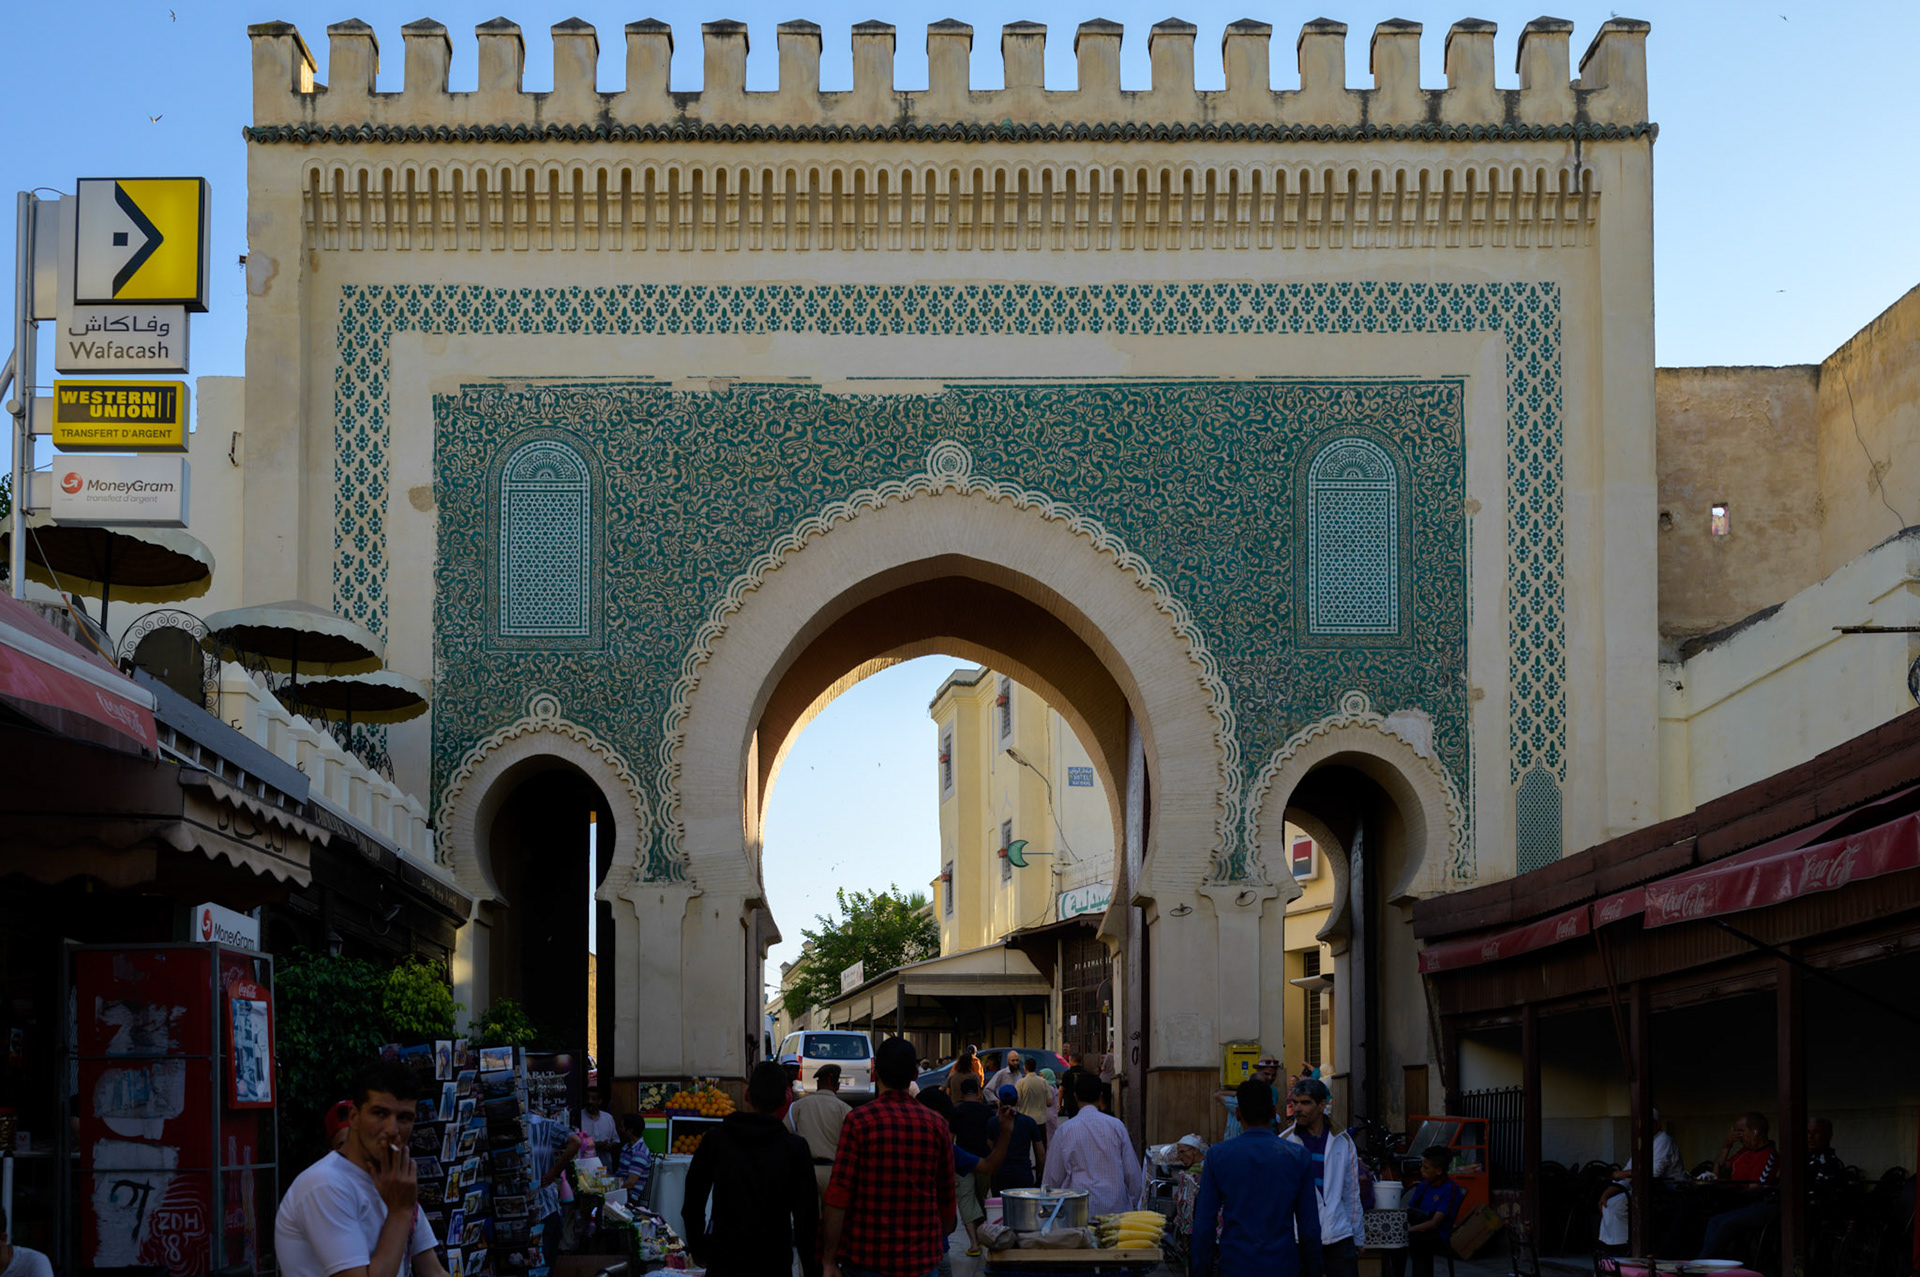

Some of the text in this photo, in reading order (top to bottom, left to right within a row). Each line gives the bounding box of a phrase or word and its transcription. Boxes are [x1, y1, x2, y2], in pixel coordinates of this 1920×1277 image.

[69, 315, 170, 337] وفاكاش
[69, 341, 169, 359] Wafacash
[60, 391, 156, 404] WESTERN
[89, 404, 156, 418] UNION
[60, 429, 173, 439] TRANSFERT D'ARGENT
[86, 479, 174, 495] MoneyGram
[213, 923, 255, 951] MoneyGram
[157, 1211, 199, 1231] ZDH
